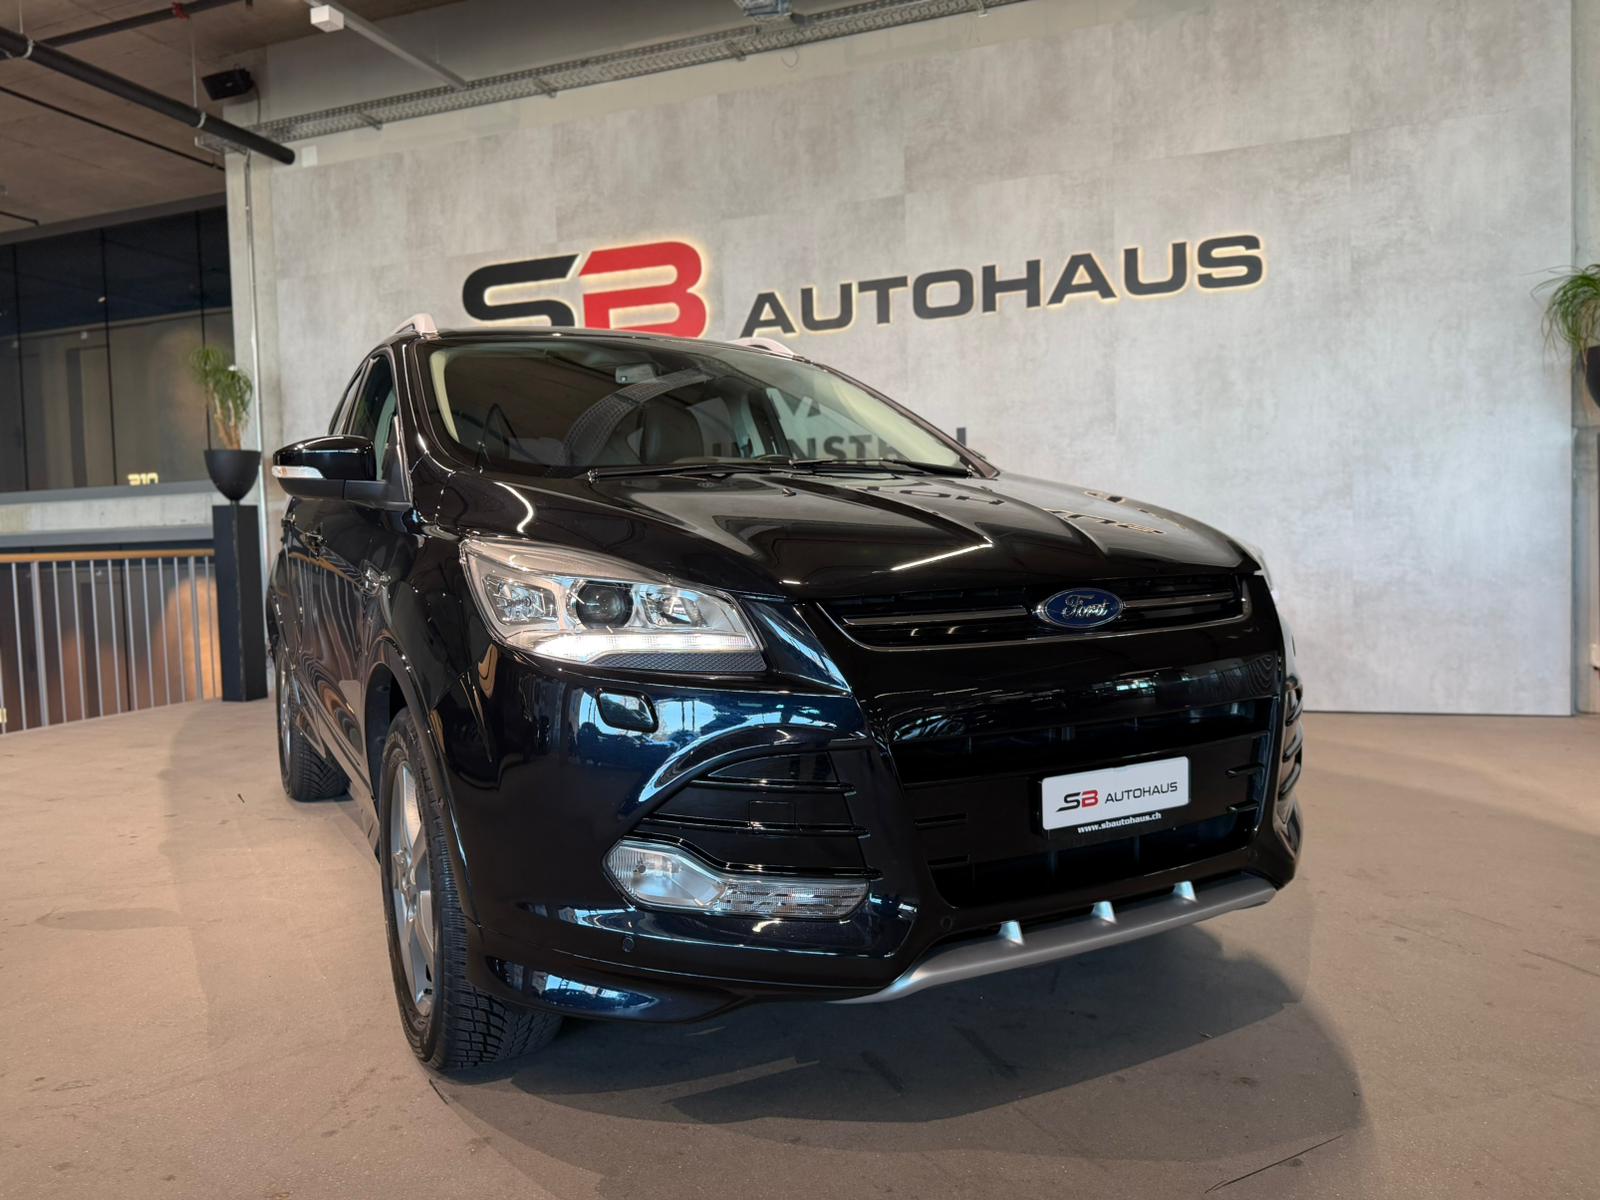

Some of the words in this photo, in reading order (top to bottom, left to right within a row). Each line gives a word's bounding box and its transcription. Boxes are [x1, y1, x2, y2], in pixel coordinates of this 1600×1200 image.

[463, 241, 708, 339] SB
[741, 235, 1264, 338] AUTOHAUS
[1061, 594, 1109, 617] Ford
[1056, 790, 1099, 812] SB
[1104, 782, 1178, 804] AUTOHAUS
[1077, 812, 1162, 833] www.sbautohaus.ch
